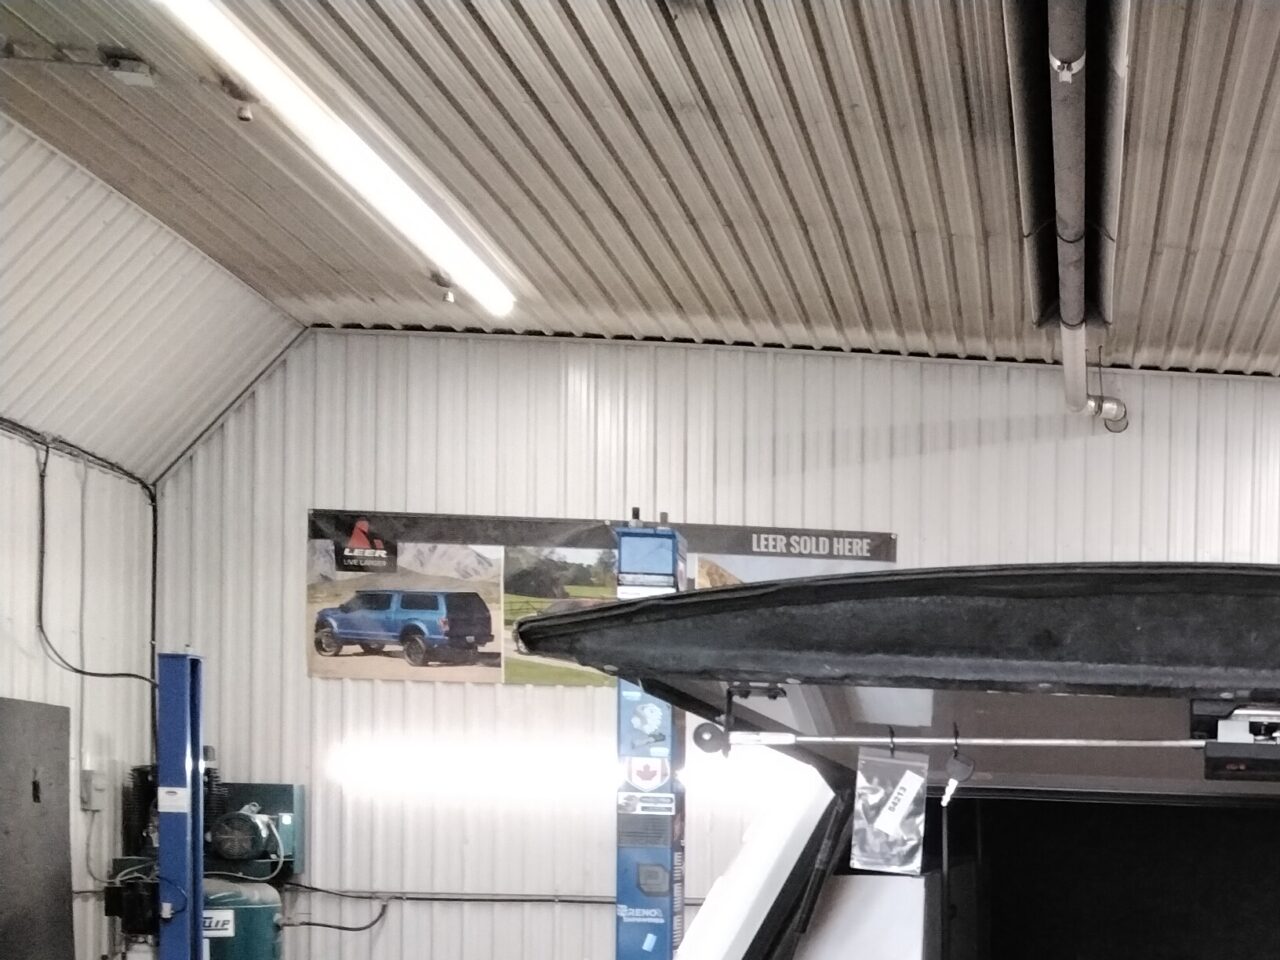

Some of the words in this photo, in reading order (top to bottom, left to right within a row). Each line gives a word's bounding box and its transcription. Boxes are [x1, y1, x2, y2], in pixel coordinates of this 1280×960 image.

[343, 548, 387, 558] LEER
[752, 533, 787, 553] LEER
[789, 535, 829, 555] SOLD
[833, 537, 871, 557] HERE
